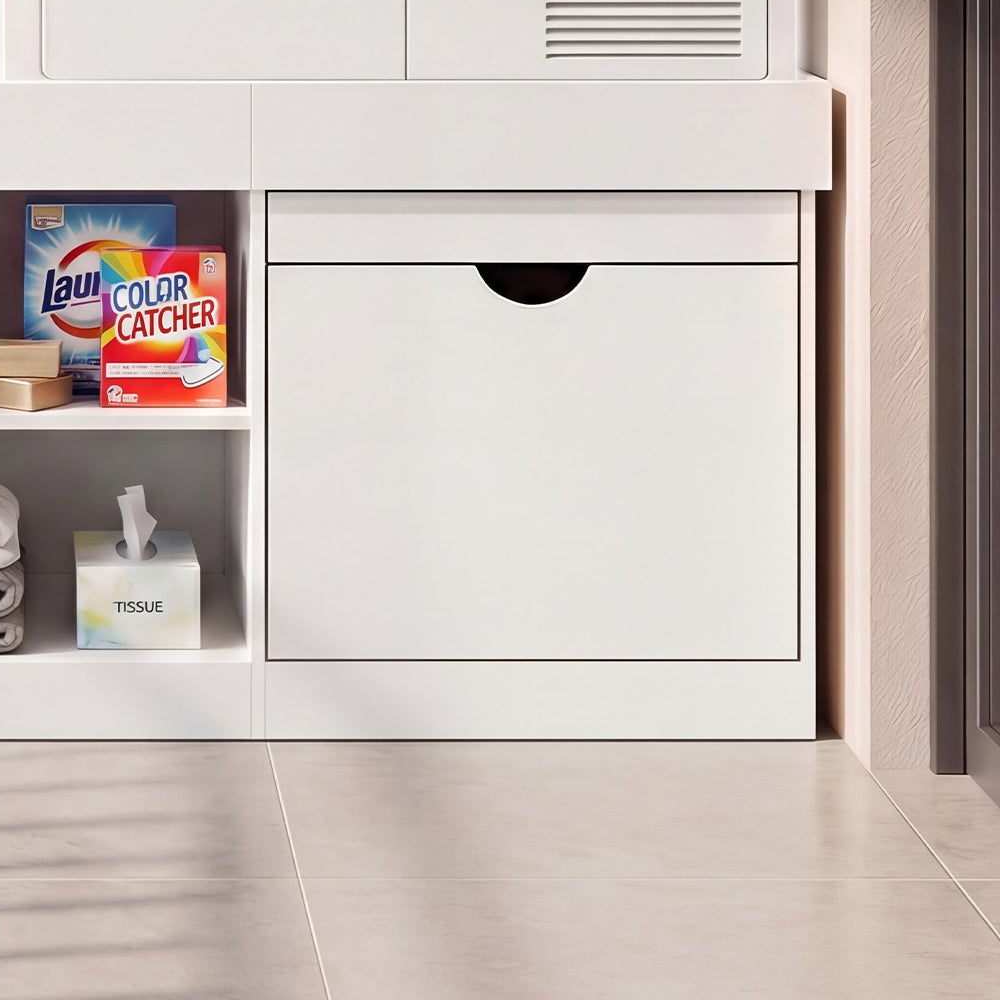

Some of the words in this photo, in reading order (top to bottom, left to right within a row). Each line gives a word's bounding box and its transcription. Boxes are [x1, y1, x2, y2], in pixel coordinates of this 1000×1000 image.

[113, 274, 188, 312] COLOR
[117, 300, 215, 341] CATCHER
[113, 601, 163, 613] TISSUE
